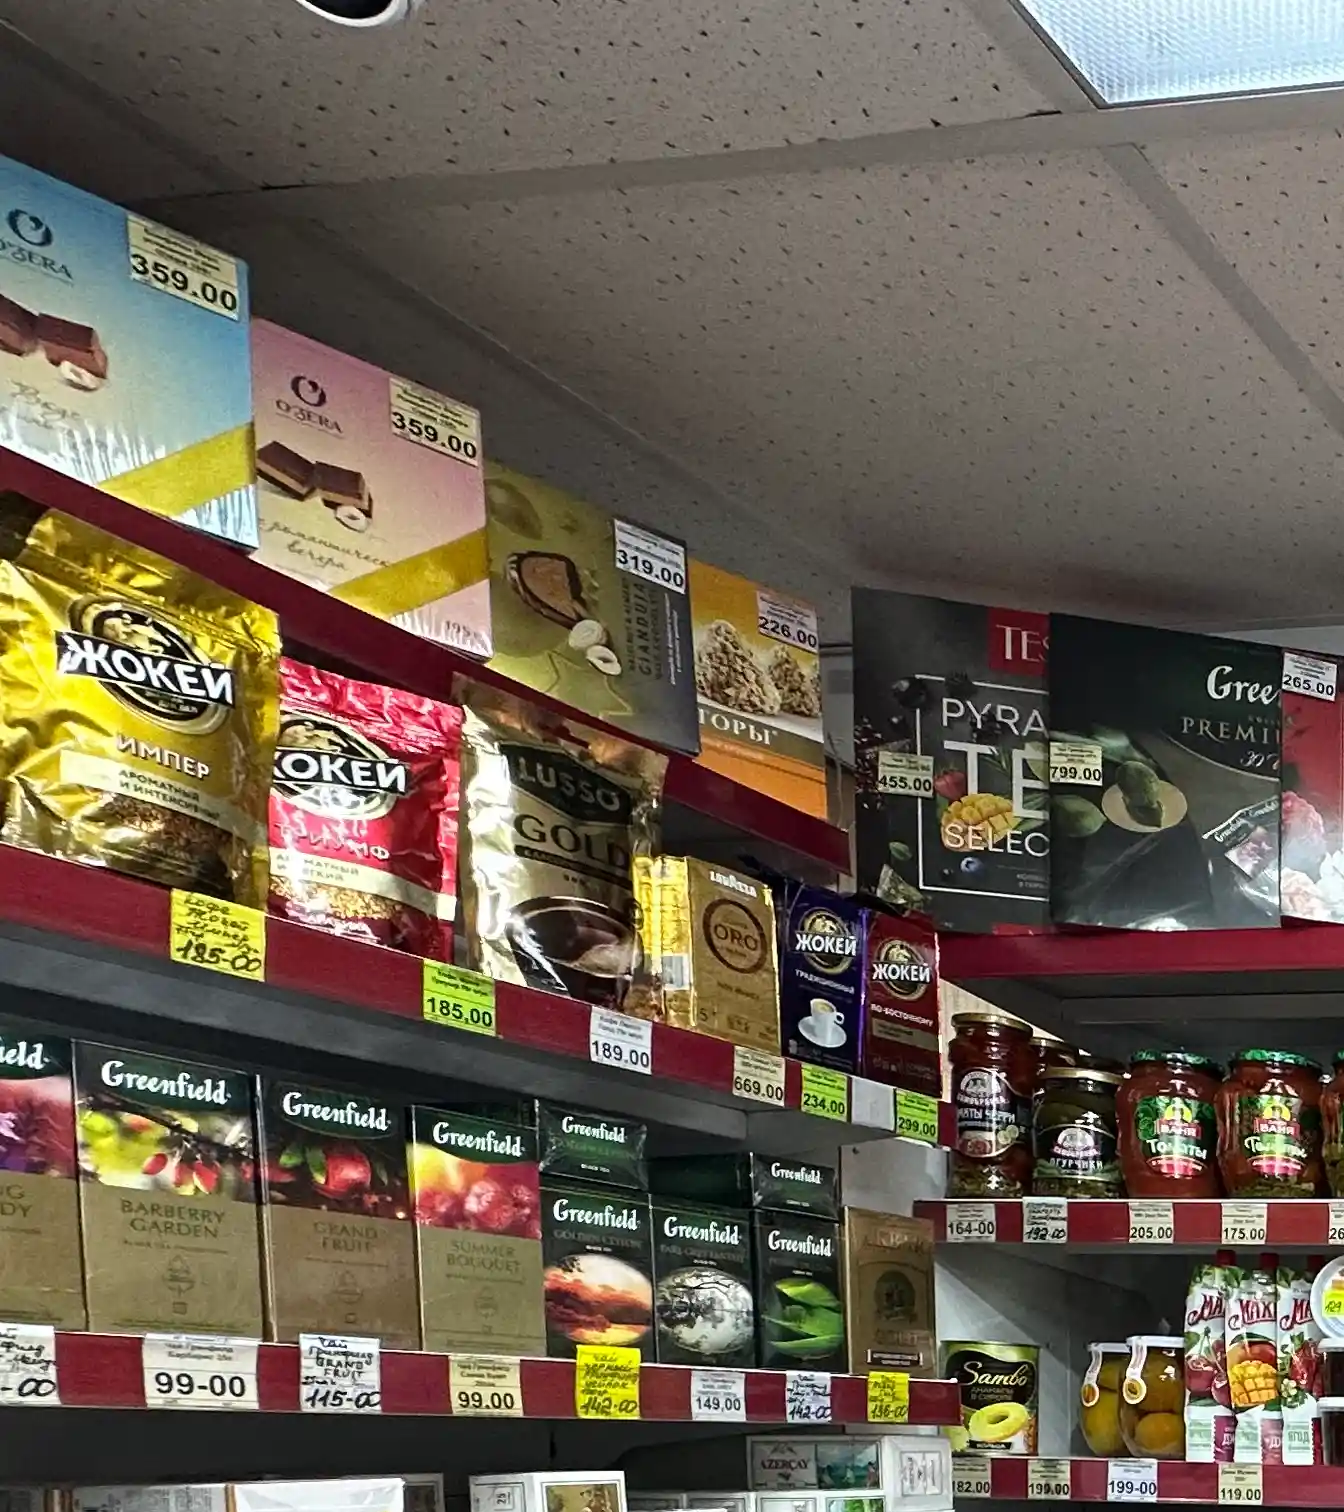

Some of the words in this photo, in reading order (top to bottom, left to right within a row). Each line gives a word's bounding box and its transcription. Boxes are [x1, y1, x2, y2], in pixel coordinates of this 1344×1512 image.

[131, 253, 237, 312] 359.00
[392, 411, 478, 460] 359.00
[616, 550, 684, 589] 319.00
[759, 617, 818, 648] 226.00
[66, 633, 233, 703] ЖОКЕЙ
[1283, 674, 1335, 699] 265.00
[116, 735, 210, 779] ИМПЕР
[518, 755, 621, 810] LUSSO
[879, 774, 932, 792] 455.00
[1050, 765, 1101, 782] 799.00
[515, 815, 630, 869] GOLD
[714, 924, 759, 950] ORO
[873, 961, 931, 983] ЖОКЕЙ
[591, 1039, 650, 1068] 189.00
[101, 1060, 229, 1105] Greenfield
[284, 1092, 389, 1131] Greenfield
[120, 1200, 225, 1224] BARBERRY
[552, 1199, 638, 1231] Greenfield
[130, 1218, 219, 1239] GARDEN
[313, 1222, 378, 1238] GRAND
[948, 1221, 995, 1236] 164-00
[1130, 1225, 1173, 1240] 205.00
[322, 1237, 376, 1253] FRUIT
[768, 1230, 833, 1256] Greenfield
[155, 1372, 246, 1396] 99-00
[963, 1360, 1028, 1386] Sambo
[1220, 1488, 1262, 1501] 119.00
